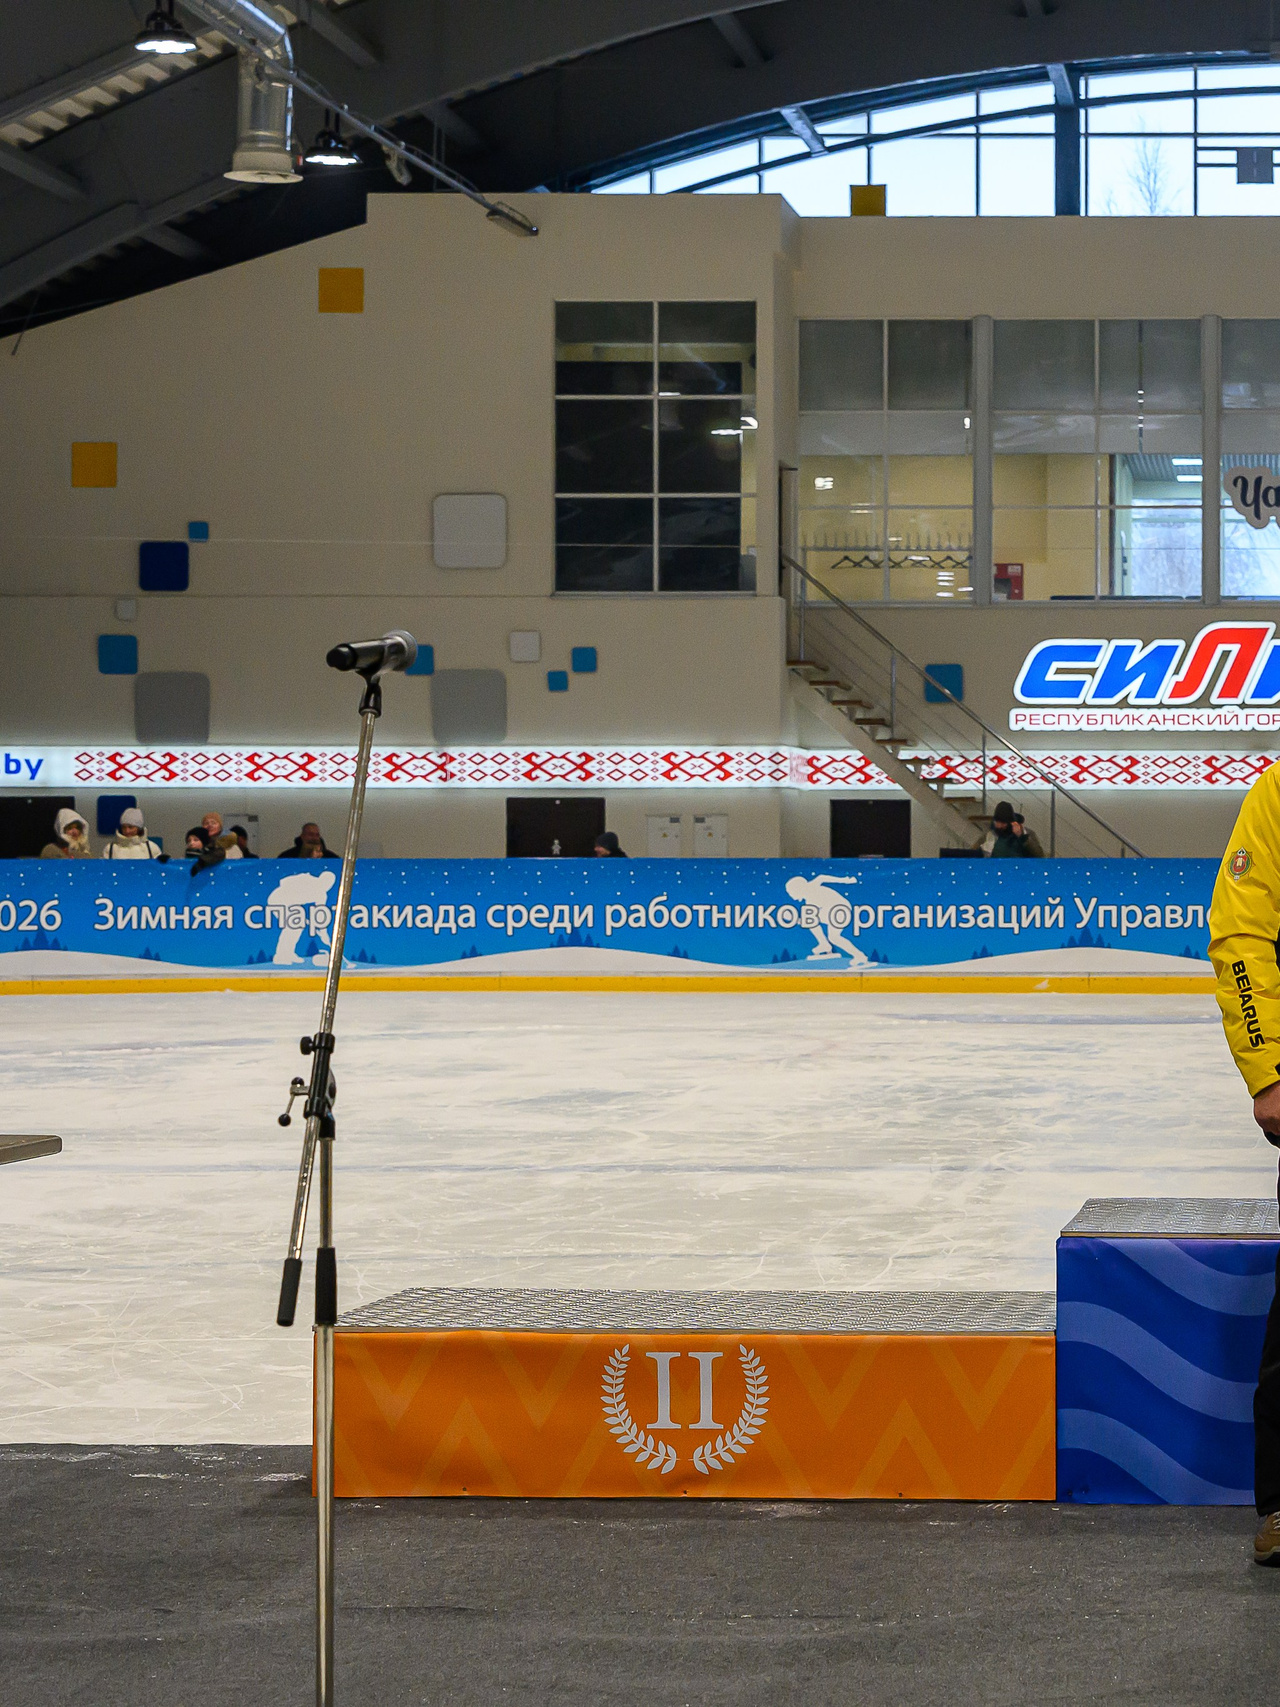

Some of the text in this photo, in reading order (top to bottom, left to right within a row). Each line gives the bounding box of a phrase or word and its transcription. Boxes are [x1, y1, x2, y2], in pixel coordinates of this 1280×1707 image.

[1014, 710, 1239, 726] РЕСПУБЛИКАНСКИЙ
[3, 752, 44, 780] by
[0, 899, 62, 931] 026
[94, 898, 233, 931] Зимняя
[244, 904, 476, 937] спаракиада
[486, 904, 594, 936] среди
[604, 895, 820, 936] работников
[828, 897, 1065, 936] организаций
[1073, 897, 1211, 936] Управл
[645, 1351, 724, 1430] II
